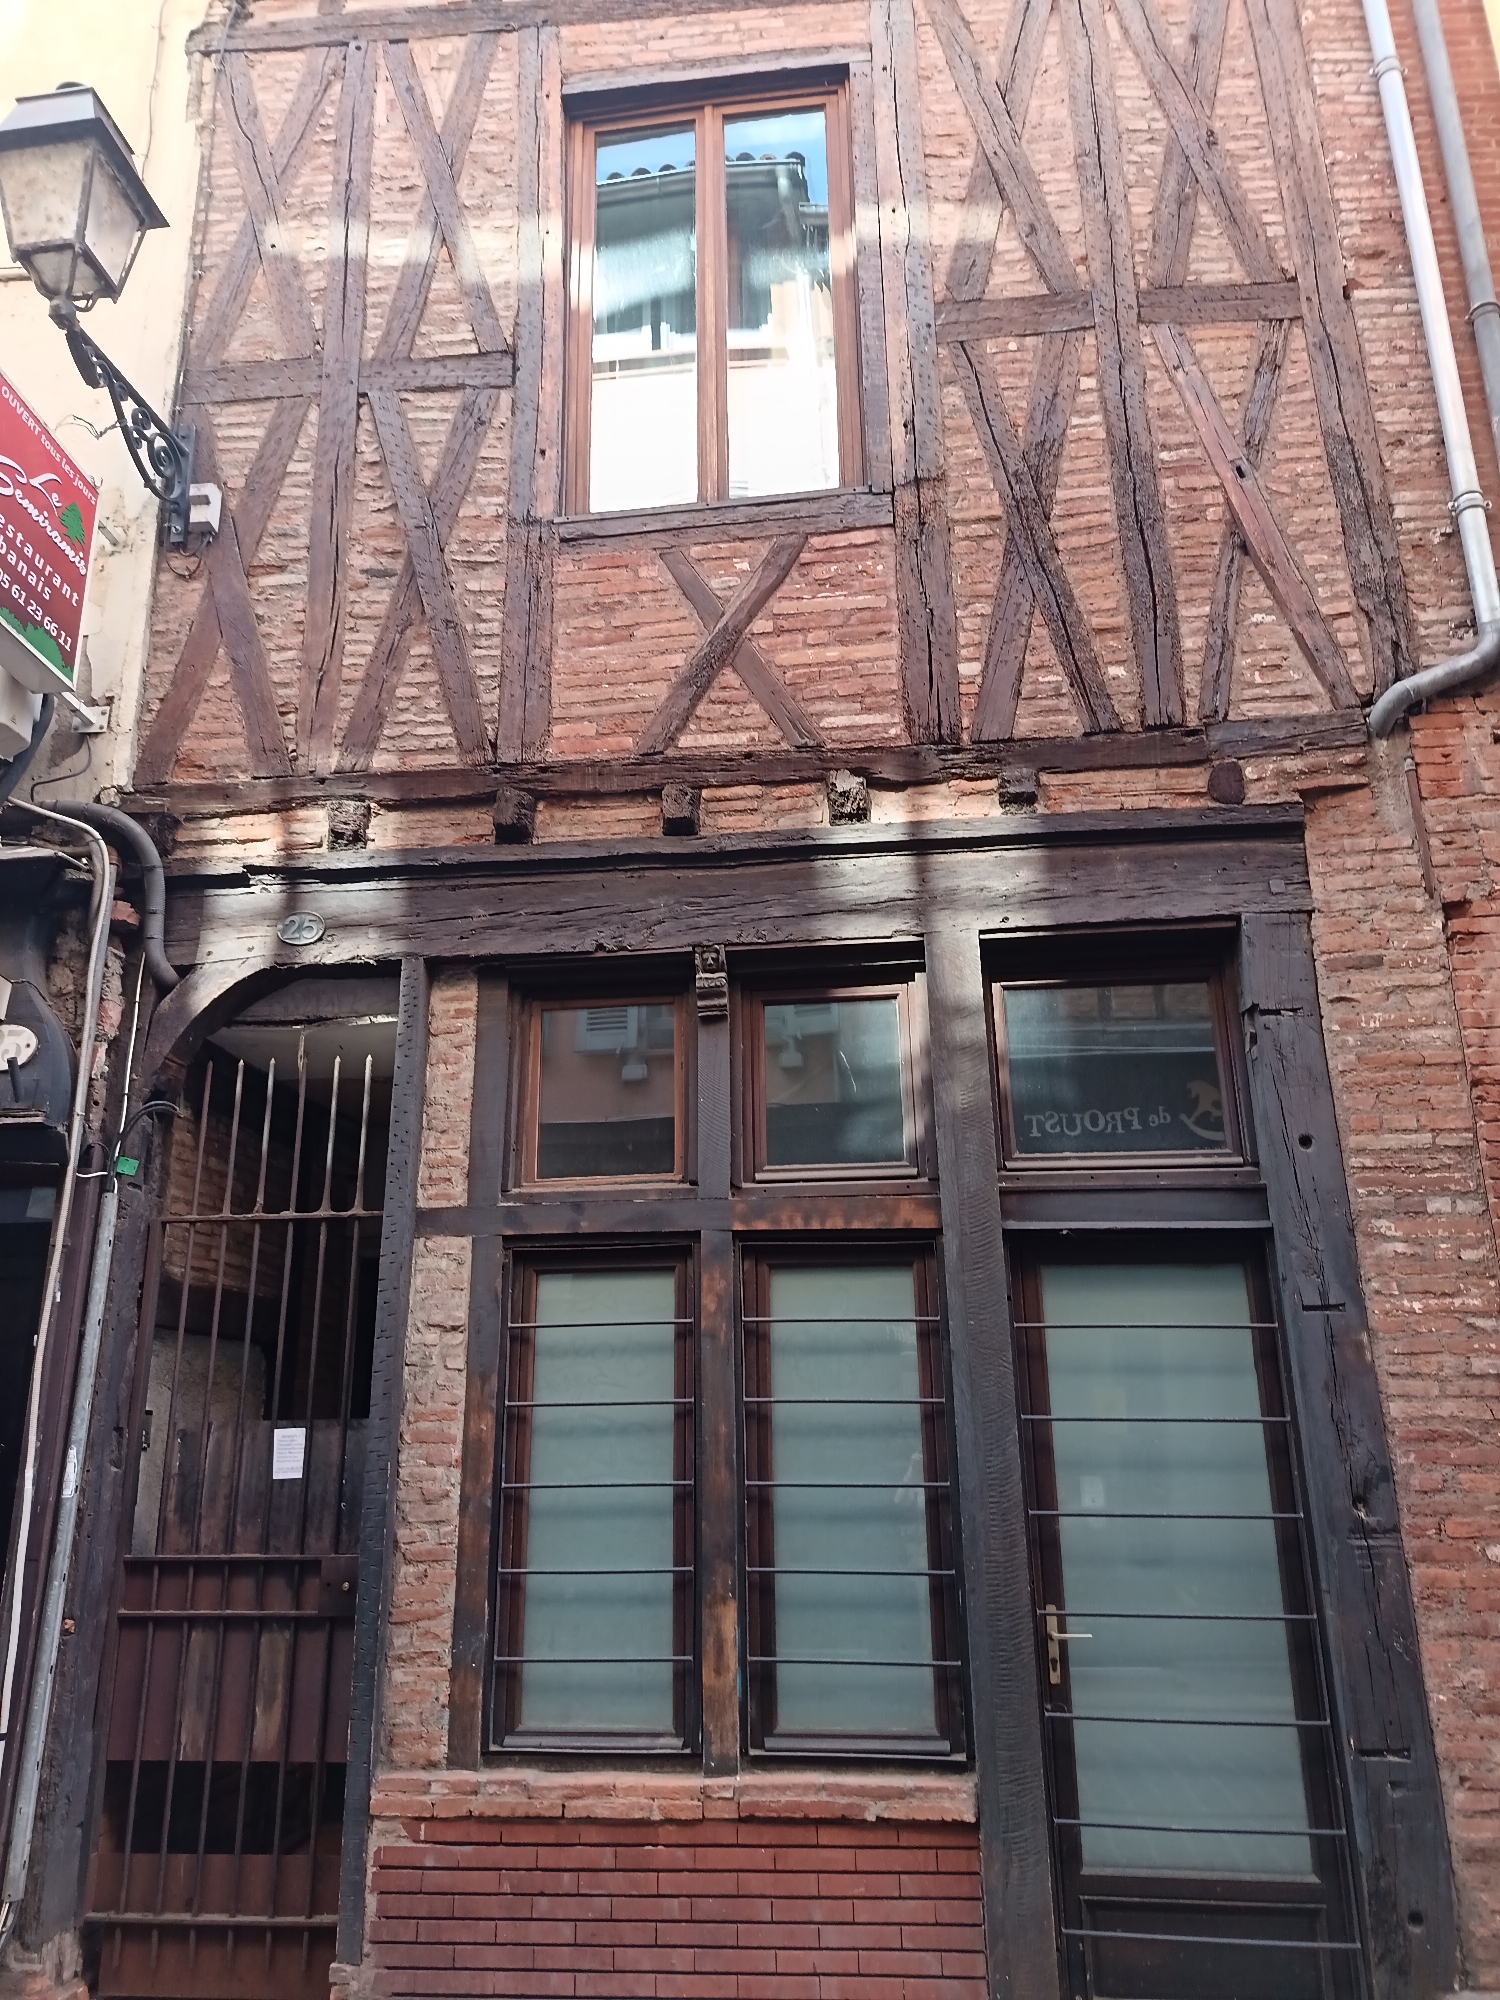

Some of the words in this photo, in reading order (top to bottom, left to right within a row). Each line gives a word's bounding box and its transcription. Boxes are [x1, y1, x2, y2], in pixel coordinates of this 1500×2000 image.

[1, 385, 41, 436] OUVERT
[40, 434, 62, 462] tous
[61, 458, 75, 479] les
[72, 474, 97, 505] jours
[29, 473, 62, 517] Le
[11, 584, 26, 606] 61
[27, 600, 43, 621] 23
[43, 616, 59, 636] 66
[58, 631, 72, 652] 11
[283, 915, 319, 939] 25
